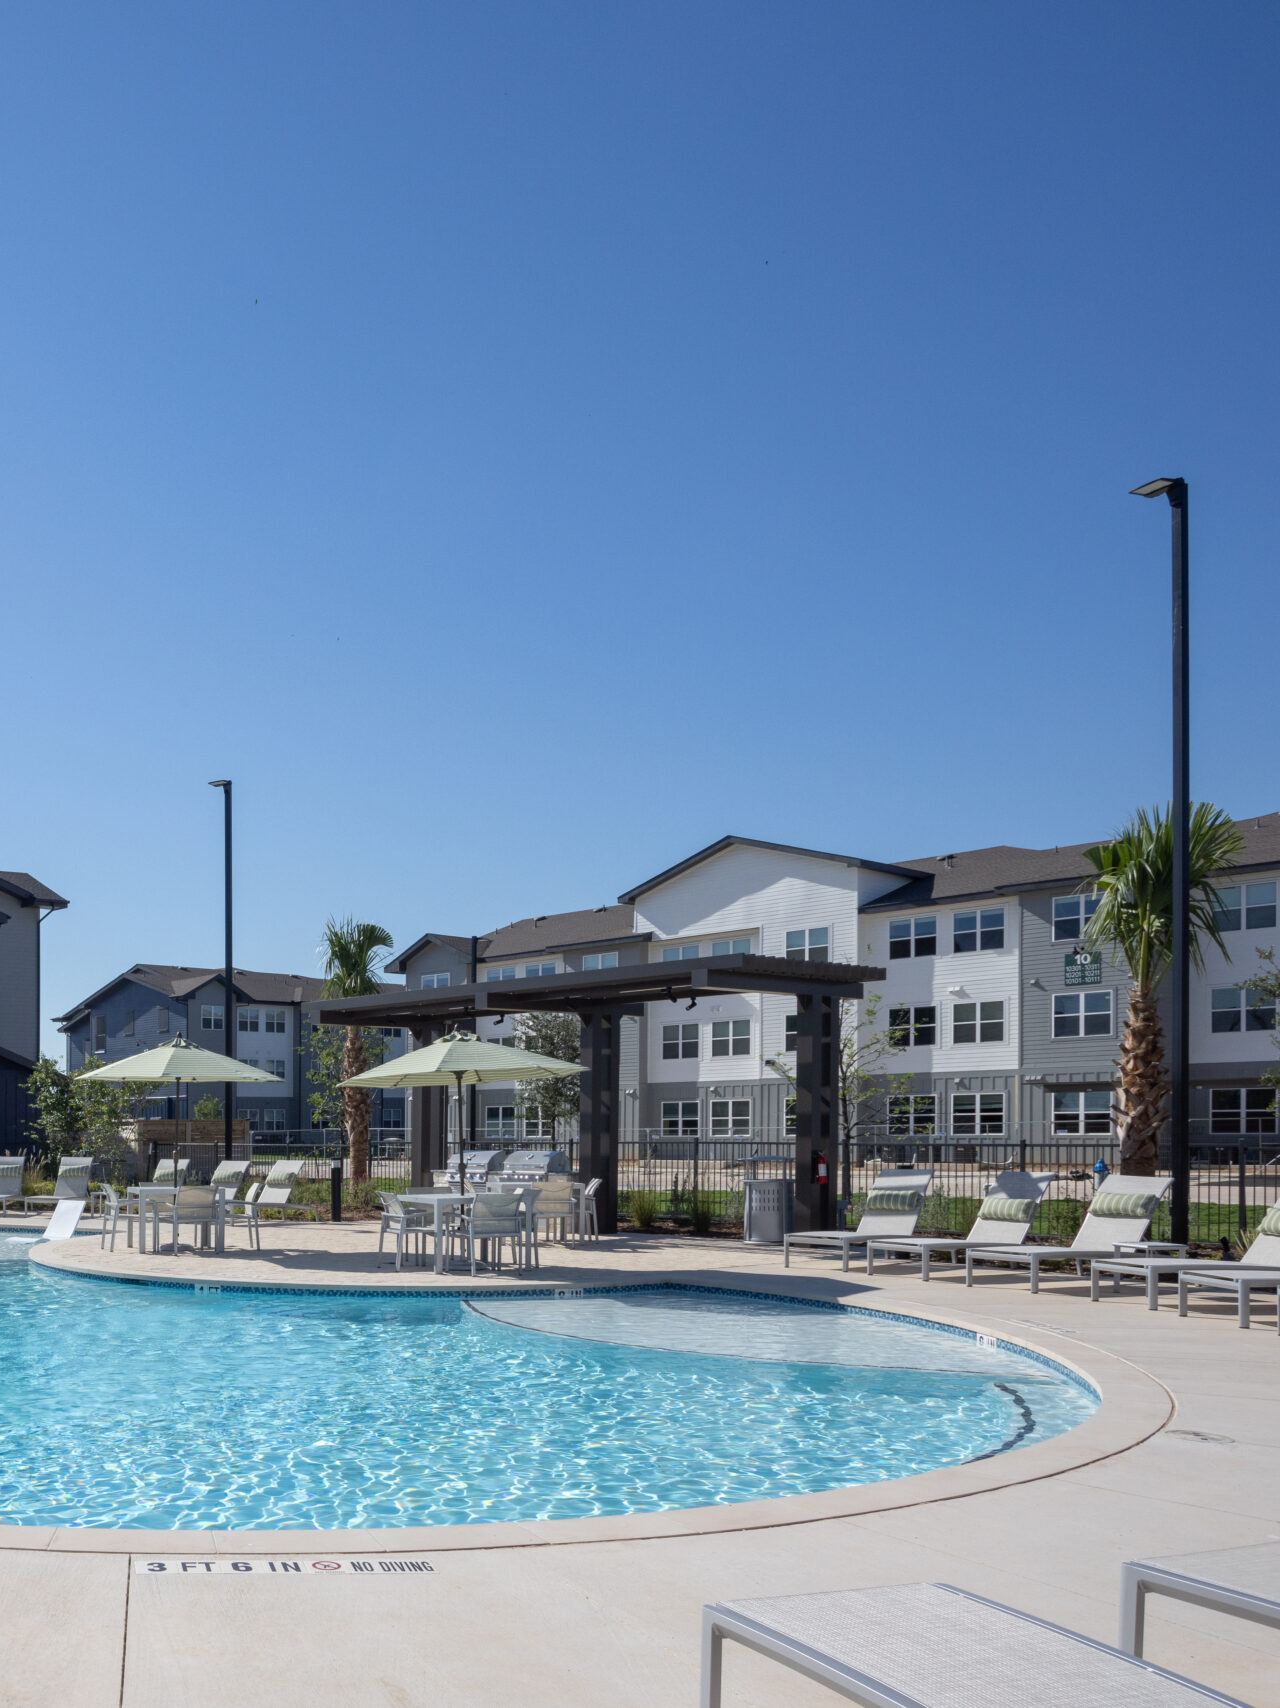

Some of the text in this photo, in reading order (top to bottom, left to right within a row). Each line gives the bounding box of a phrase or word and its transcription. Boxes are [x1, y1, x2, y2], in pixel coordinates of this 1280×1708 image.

[1074, 953, 1091, 964] 10
[146, 1561, 435, 1573] 3 FT 6 IN NO DIVING
